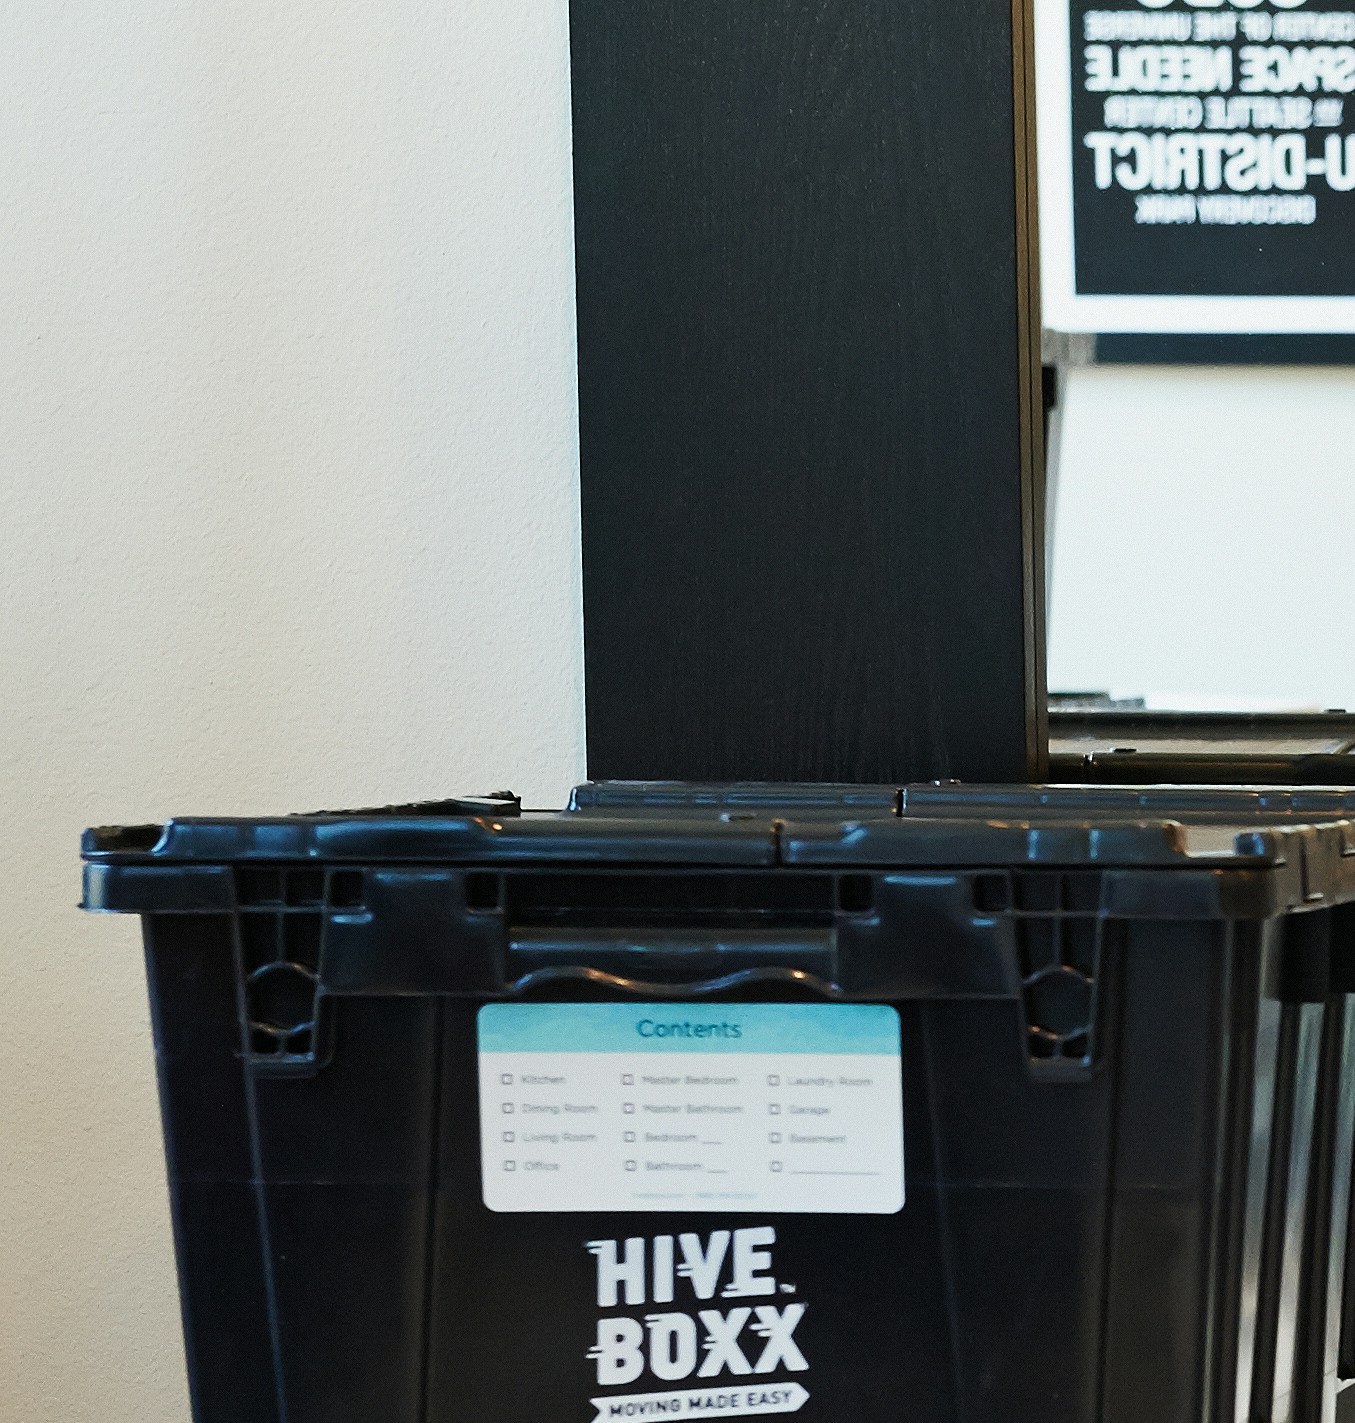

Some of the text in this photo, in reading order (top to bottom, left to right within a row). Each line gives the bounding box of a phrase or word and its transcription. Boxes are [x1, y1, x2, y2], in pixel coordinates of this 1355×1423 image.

[636, 1019, 741, 1038] Contents
[521, 1075, 565, 1084] Kitchen
[642, 1076, 738, 1085] Master Bedroom
[788, 1077, 873, 1087] Laundry Room
[522, 1103, 598, 1115] Dining Room
[642, 1104, 743, 1114] Master Bathroom
[523, 1132, 596, 1144] Living Room
[644, 1132, 697, 1142] Bedroom
[524, 1161, 559, 1171] Office
[645, 1161, 702, 1171] Bathroom
[584, 1226, 776, 1307] HIVE
[585, 1302, 809, 1385] BOXX
[610, 1390, 792, 1417] MOVING MADE EASY
